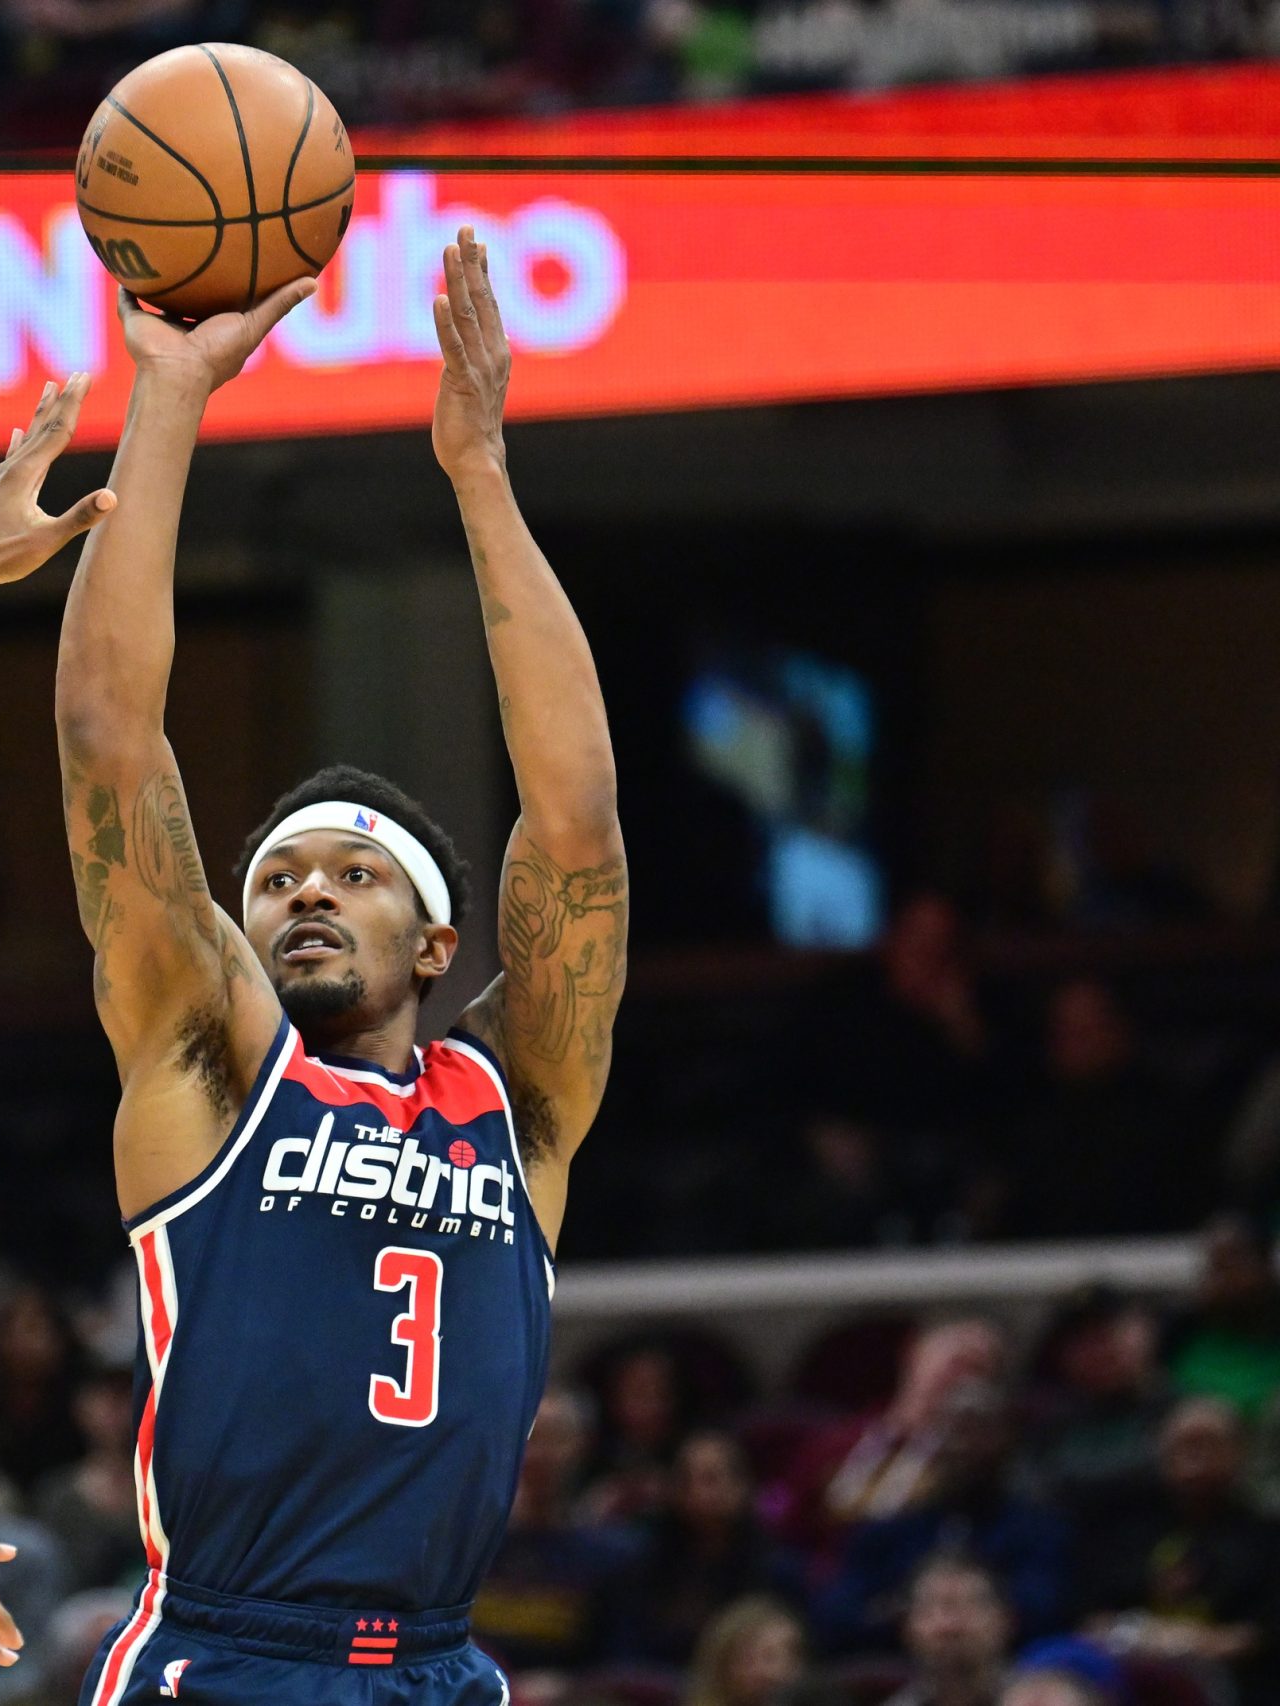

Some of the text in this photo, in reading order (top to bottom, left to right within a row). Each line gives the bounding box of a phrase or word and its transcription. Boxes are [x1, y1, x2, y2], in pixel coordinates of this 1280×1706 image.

[250, 170, 627, 373] ubo
[261, 1111, 516, 1226] district
[354, 1124, 402, 1144] THE
[259, 1195, 515, 1246] OF COLUMBIA
[368, 1246, 444, 1428] 3
